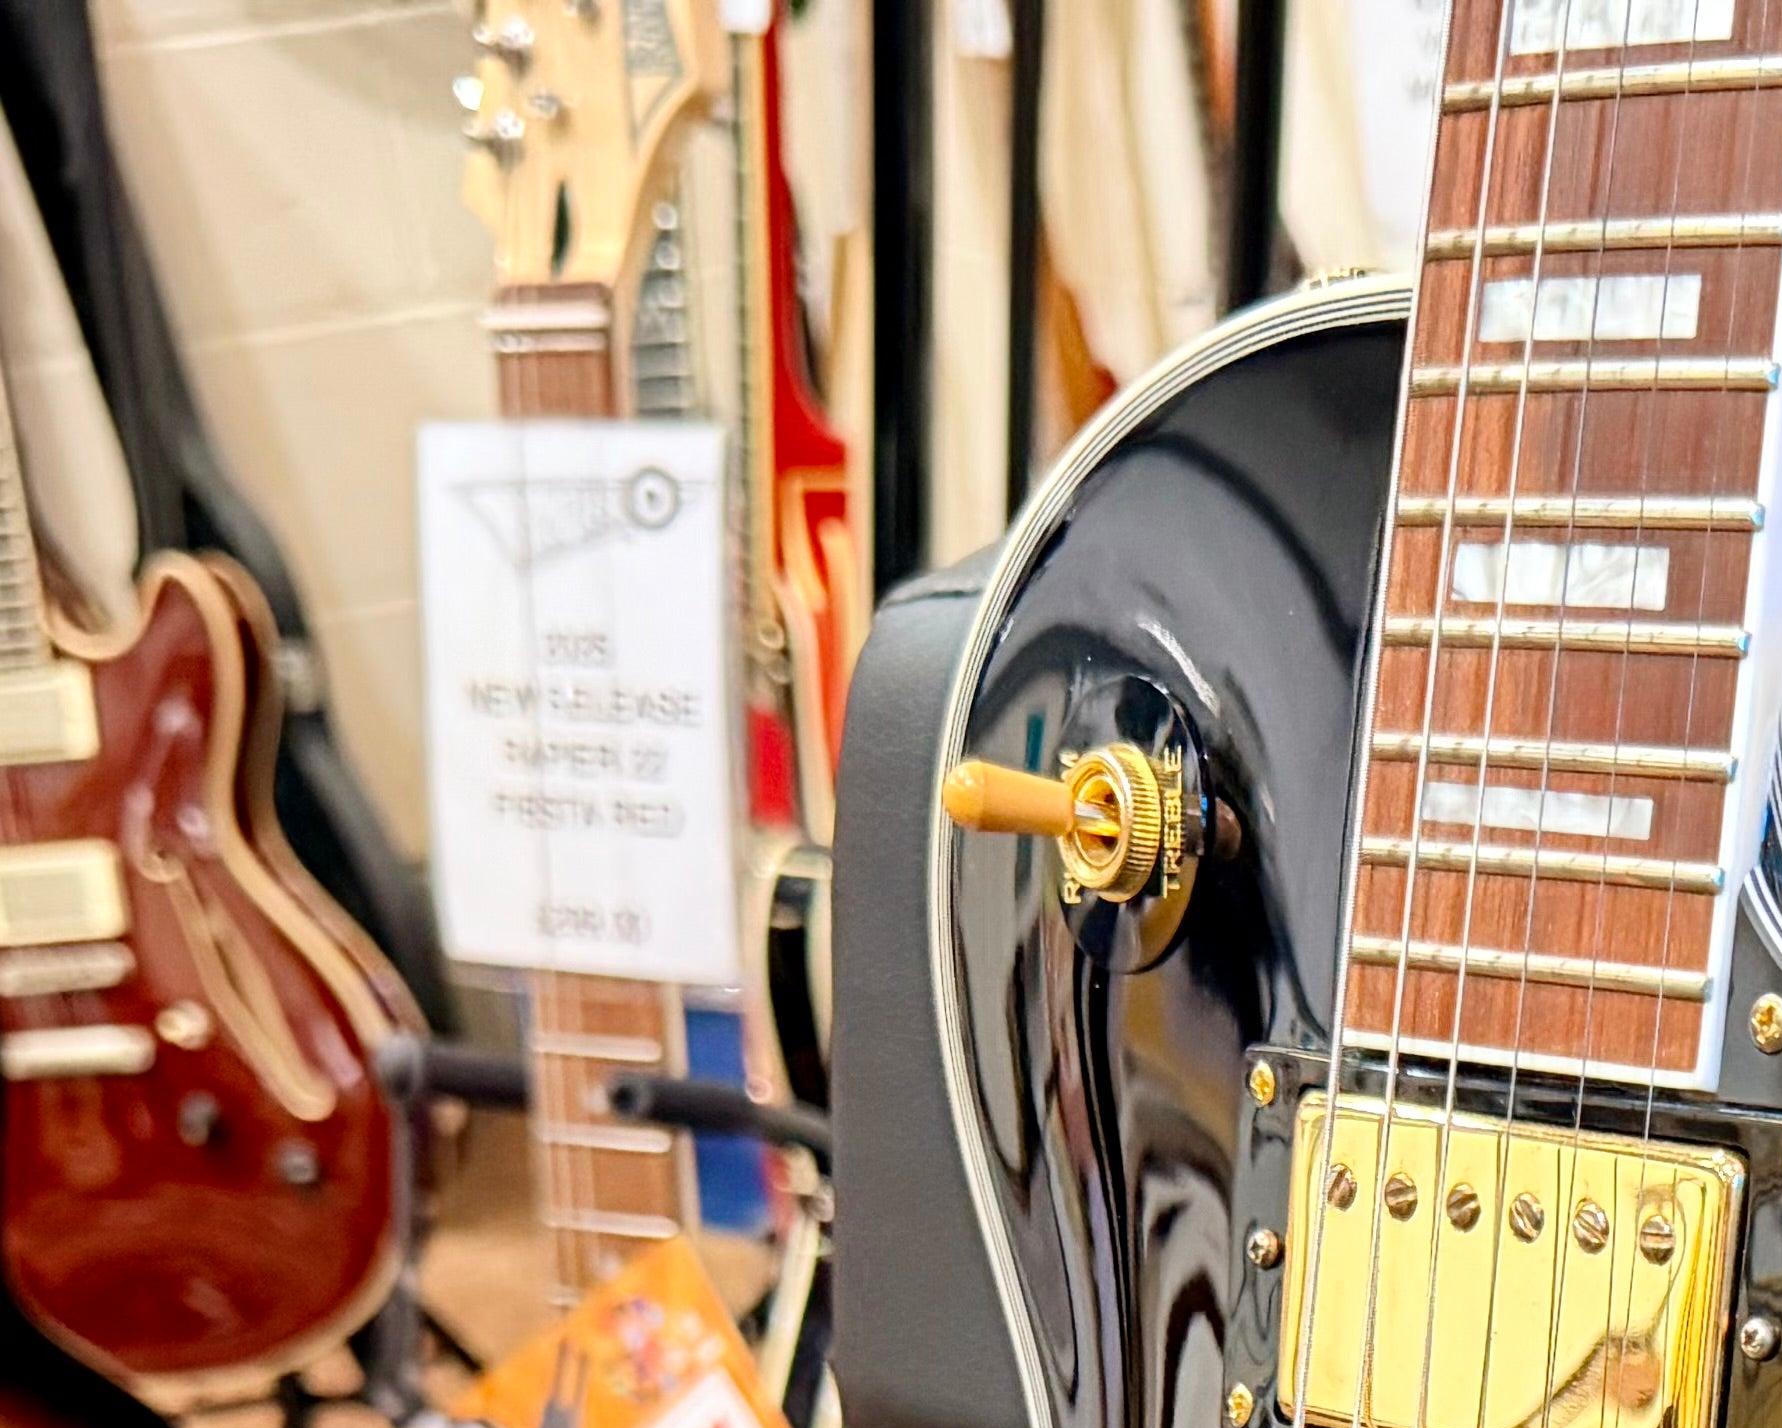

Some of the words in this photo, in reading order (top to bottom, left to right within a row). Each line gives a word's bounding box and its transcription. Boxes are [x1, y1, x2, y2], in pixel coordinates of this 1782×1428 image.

[466, 680, 536, 716] NEW
[546, 685, 703, 726] RELEASE
[1163, 744, 1182, 899] TREBLE
